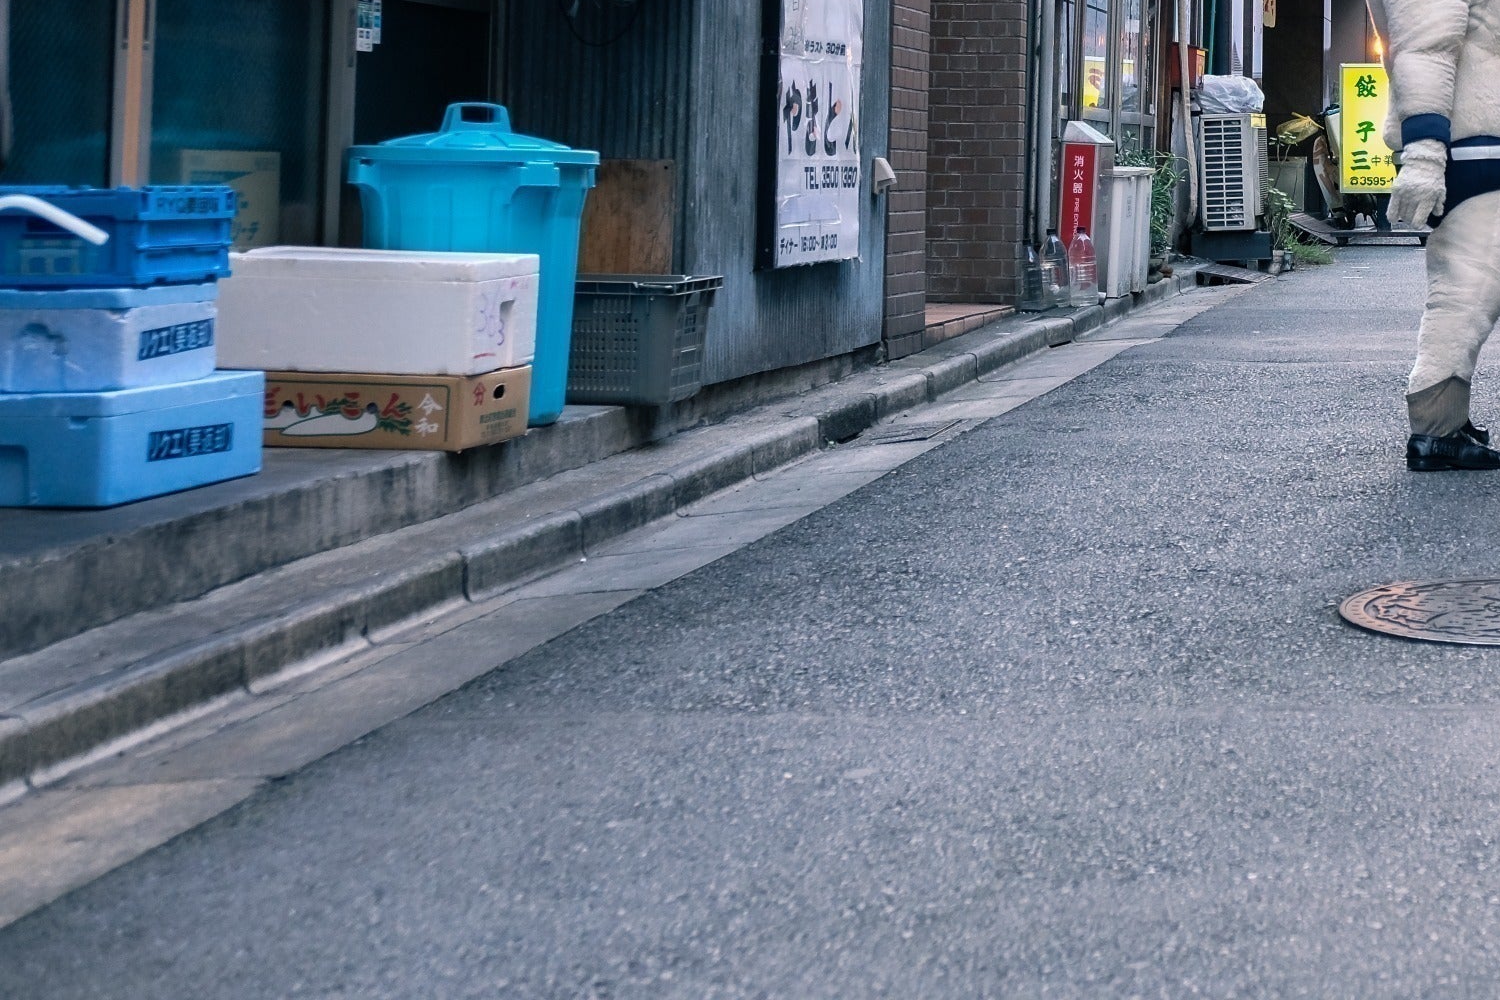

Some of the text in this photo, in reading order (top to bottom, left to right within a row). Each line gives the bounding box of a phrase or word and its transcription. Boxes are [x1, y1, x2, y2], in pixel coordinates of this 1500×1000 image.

[805, 166, 819, 189] TEL
[1072, 155, 1085, 194] 消火器
